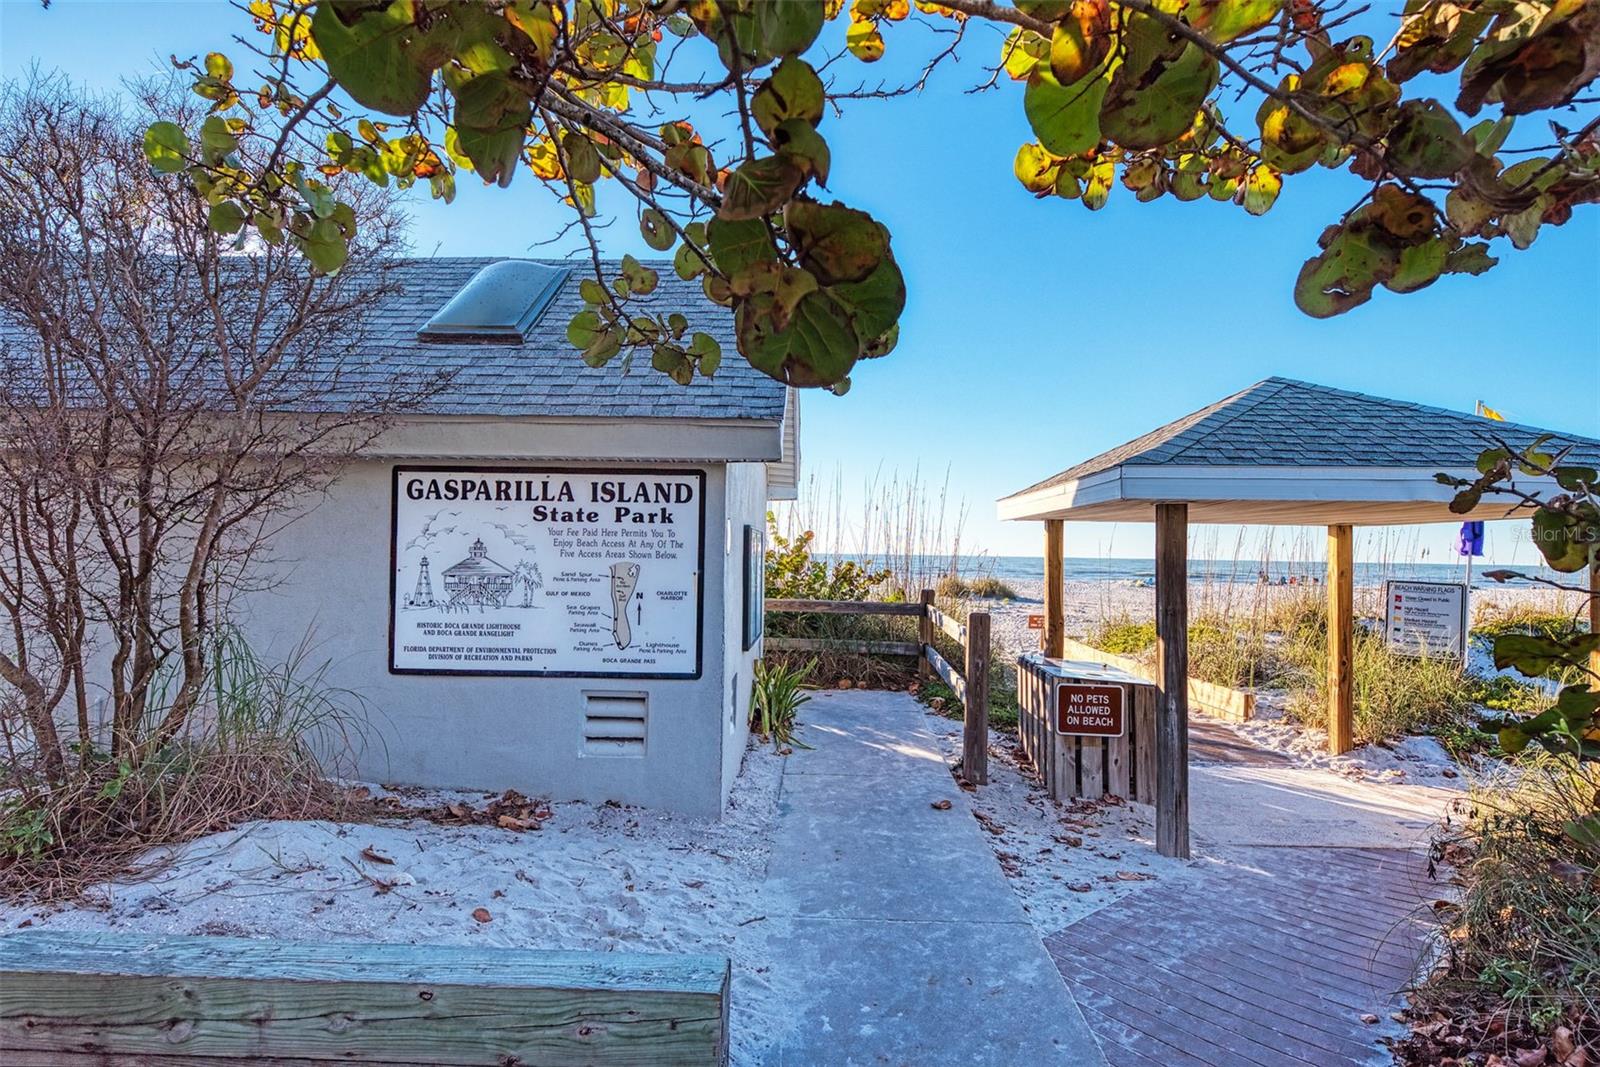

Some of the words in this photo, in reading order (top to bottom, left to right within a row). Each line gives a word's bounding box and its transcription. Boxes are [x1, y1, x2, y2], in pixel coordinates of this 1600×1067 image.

[406, 479, 575, 501] GASPARILLA
[591, 481, 693, 504] ISLAND
[533, 506, 599, 522] State
[614, 506, 674, 523] Park
[548, 527, 564, 536] Your
[566, 528, 579, 536] Fee
[582, 528, 598, 536] Paid
[601, 528, 618, 537] Here
[621, 529, 648, 538] Permits
[651, 529, 664, 538] You
[668, 529, 676, 538] To
[553, 538, 574, 549] Enjoy
[576, 538, 598, 547] Beach
[601, 539, 625, 548] Access
[628, 540, 637, 548] At
[640, 540, 654, 550] Any
[657, 540, 666, 548] Of
[670, 540, 684, 548] The
[560, 549, 574, 558] Five
[578, 550, 602, 558] Access
[605, 550, 626, 558] Areas
[628, 550, 652, 559] Shown
[655, 550, 678, 560] Below.
[1071, 694, 1083, 703] NO
[1086, 695, 1110, 704] PETS
[1067, 705, 1111, 715] ALLOWED
[1066, 716, 1080, 725] ON
[1082, 717, 1114, 726] BEACH
